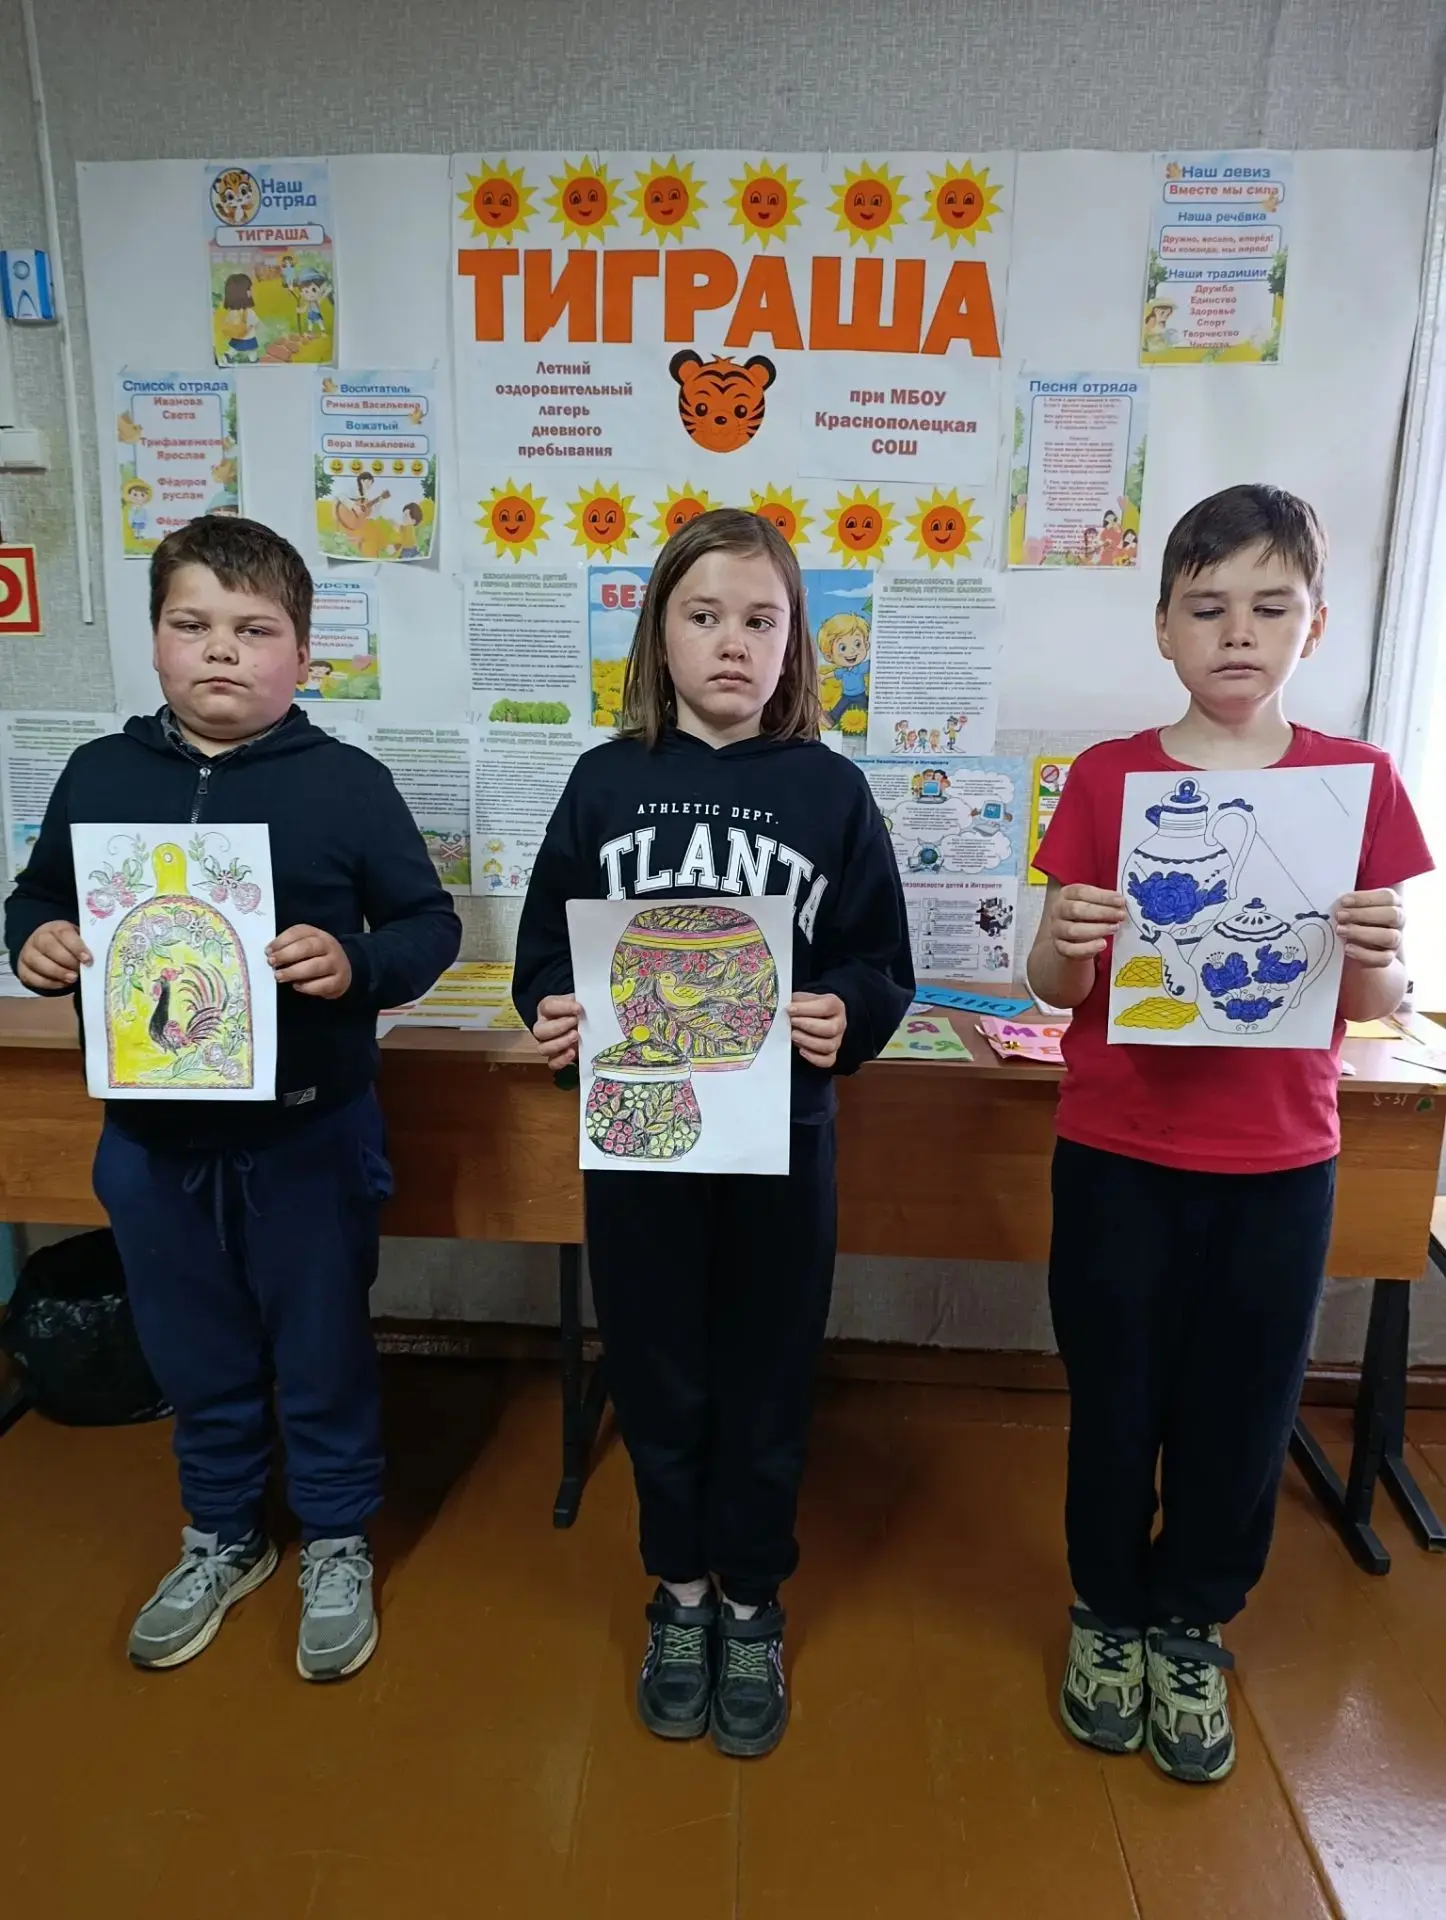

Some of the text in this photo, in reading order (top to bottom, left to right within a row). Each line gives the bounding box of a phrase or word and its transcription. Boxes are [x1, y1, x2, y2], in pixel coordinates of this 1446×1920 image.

[1182, 166, 1271, 179] Наш девиз
[261, 179, 302, 193] Наш
[1169, 185, 1279, 195] Вместе мы сила
[261, 195, 316, 210] отряд
[1178, 210, 1267, 224] Наша речёвка
[236, 228, 309, 242] ТИГРАША
[1169, 268, 1268, 280] Наши традиции
[1195, 284, 1234, 294] Дружба
[457, 248, 1002, 358] ТИГРАША
[1190, 296, 1237, 304] Единство
[1190, 307, 1236, 316] Здоровье
[1197, 318, 1227, 327] Спорт
[1183, 329, 1240, 339] Творчество
[536, 361, 591, 375] Летний
[123, 380, 229, 393] Список отряда
[340, 384, 411, 394] Воспитатель
[495, 382, 633, 397] оздоровительный
[1029, 380, 1138, 395] Песня отряда
[153, 397, 203, 406] Иванова
[850, 389, 947, 406] при МБОУ
[326, 400, 421, 409] Римма Васильевна
[162, 410, 196, 420] Света
[538, 405, 590, 418] лагерь
[346, 420, 399, 431] Вожатый
[815, 411, 977, 434] Краснополецкая
[531, 425, 602, 438] дневного
[327, 439, 416, 449] Вера Михайловна
[518, 443, 613, 458] пребывания
[872, 438, 918, 456] СОШ
[157, 451, 206, 461] Ярослав
[157, 477, 207, 487] Фёдоров
[162, 491, 204, 501] руслан
[637, 803, 779, 825] ATHLETIC DEPT.
